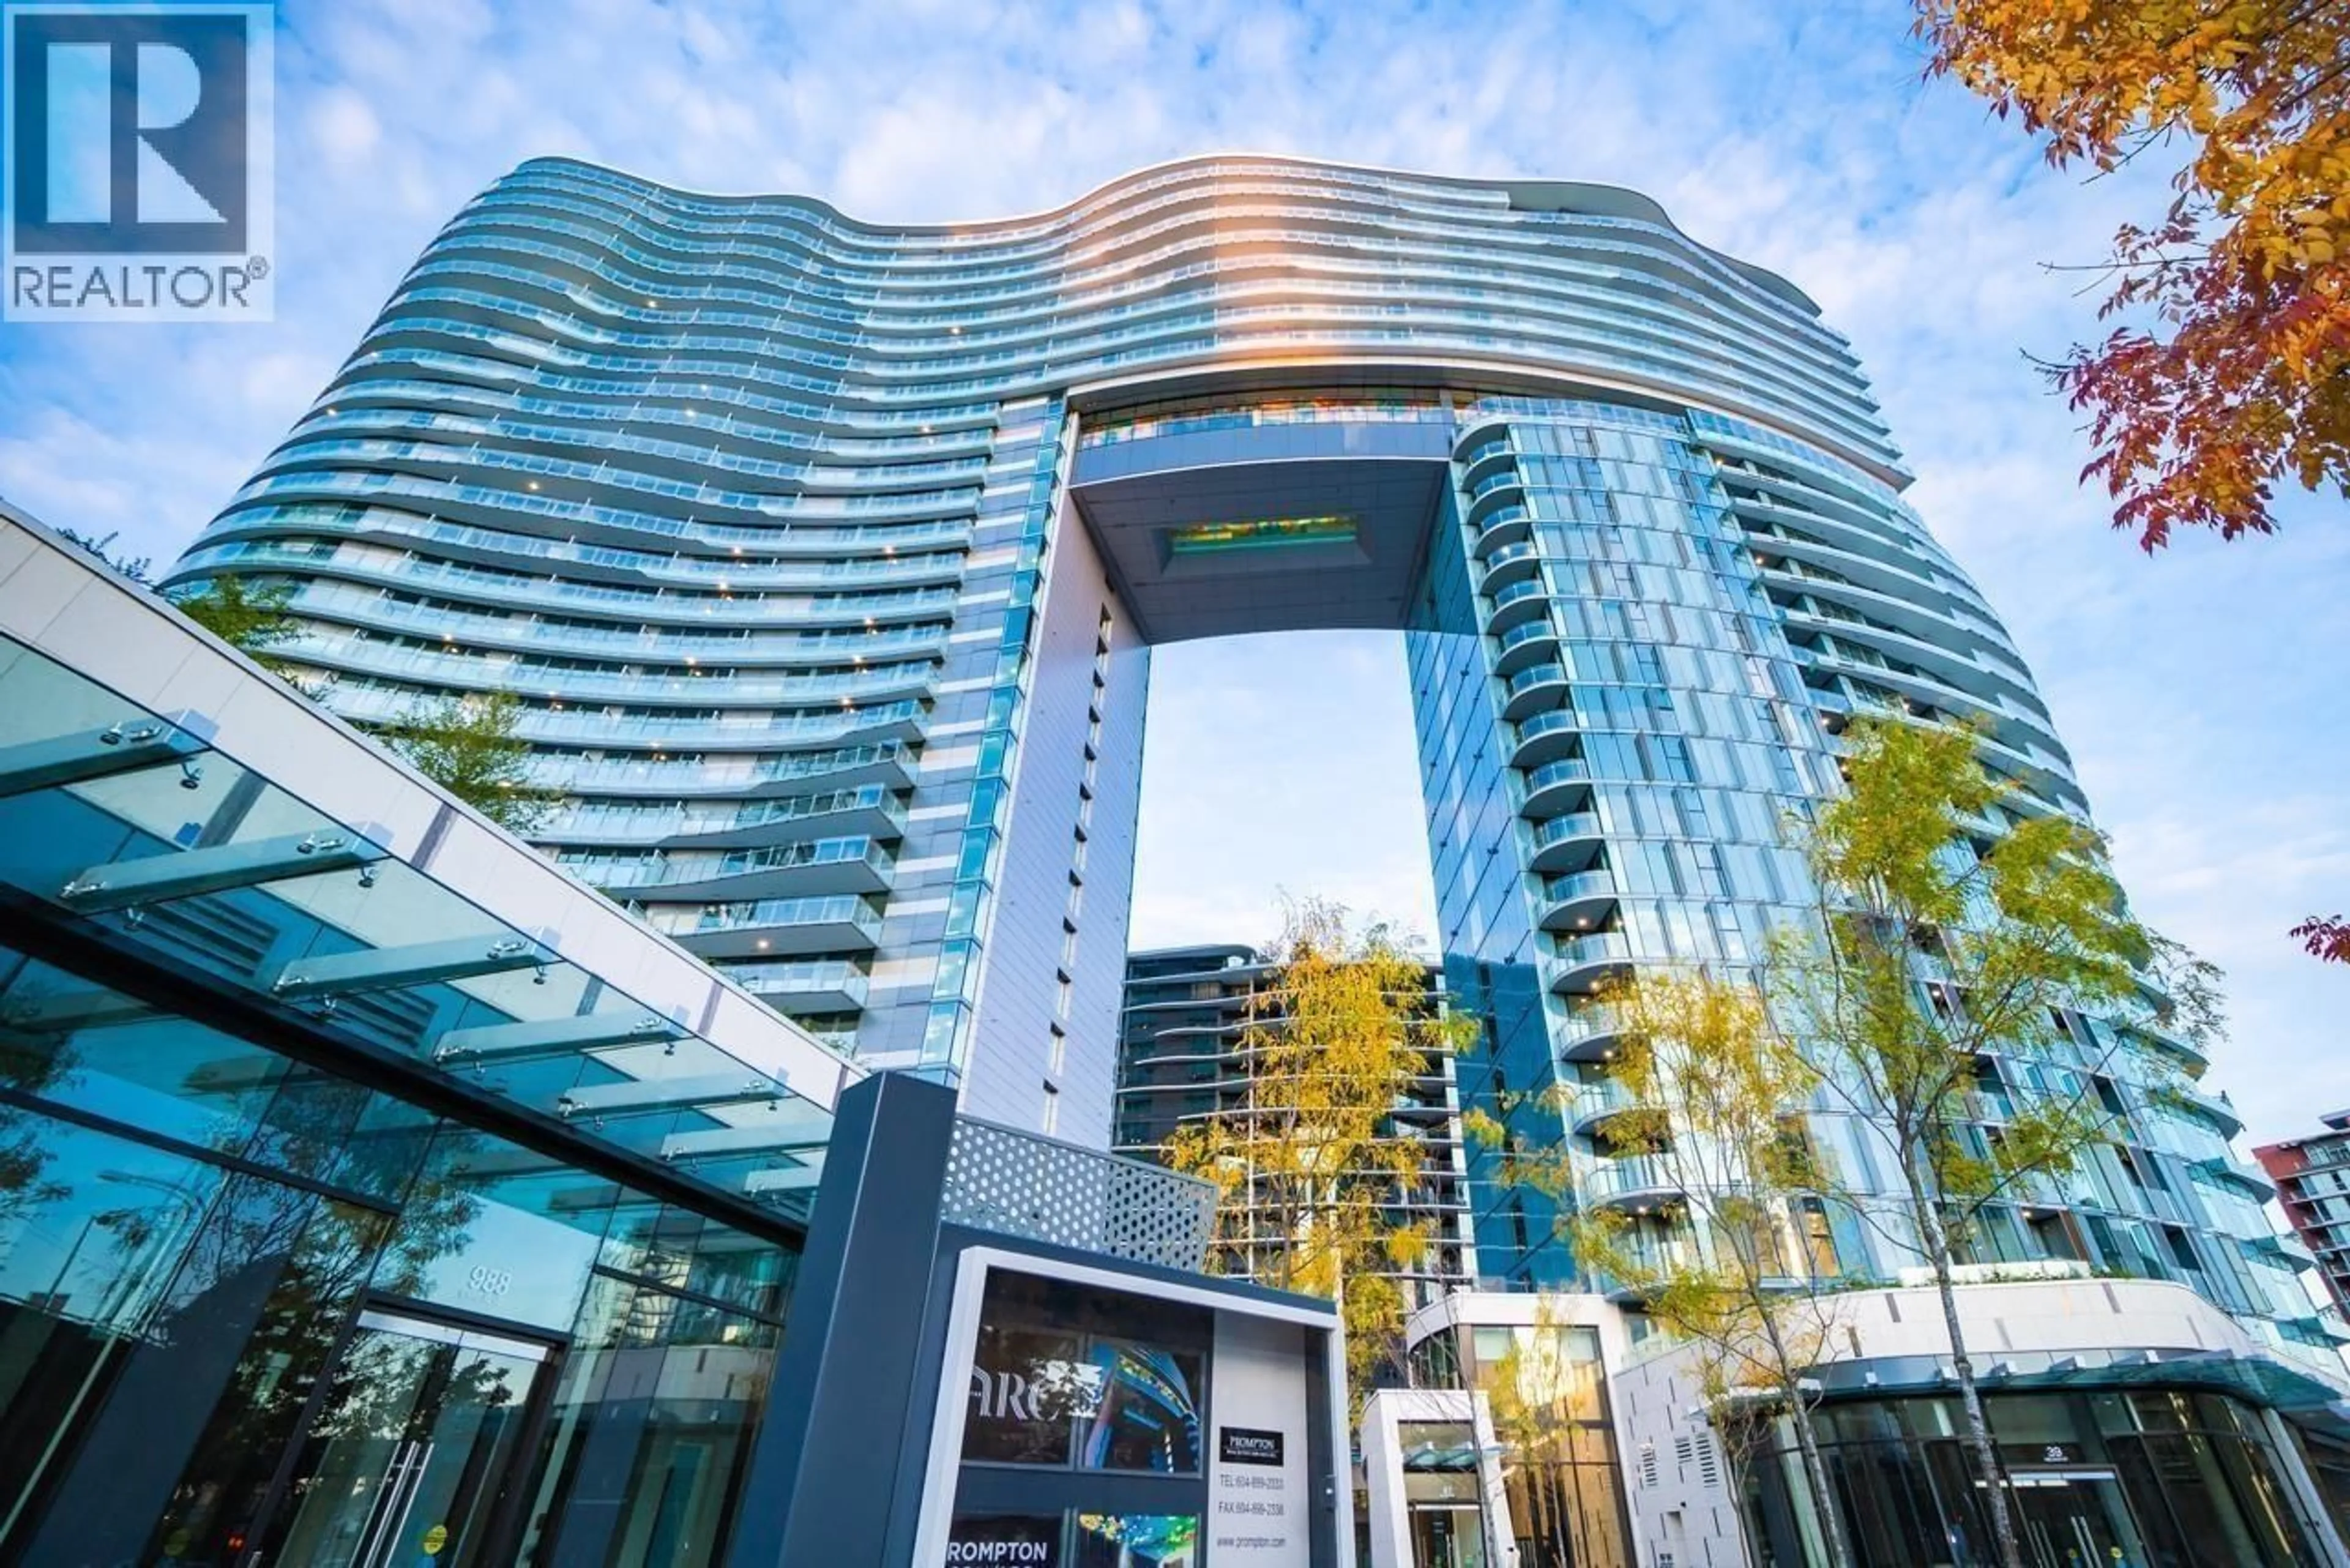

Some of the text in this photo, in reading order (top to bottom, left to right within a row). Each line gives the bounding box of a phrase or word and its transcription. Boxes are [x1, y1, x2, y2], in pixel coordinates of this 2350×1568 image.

[468, 1264, 512, 1296] 988
[947, 1542, 1048, 1561] ROMPTON
[1217, 1536, 1286, 1549] www.prompton.com
